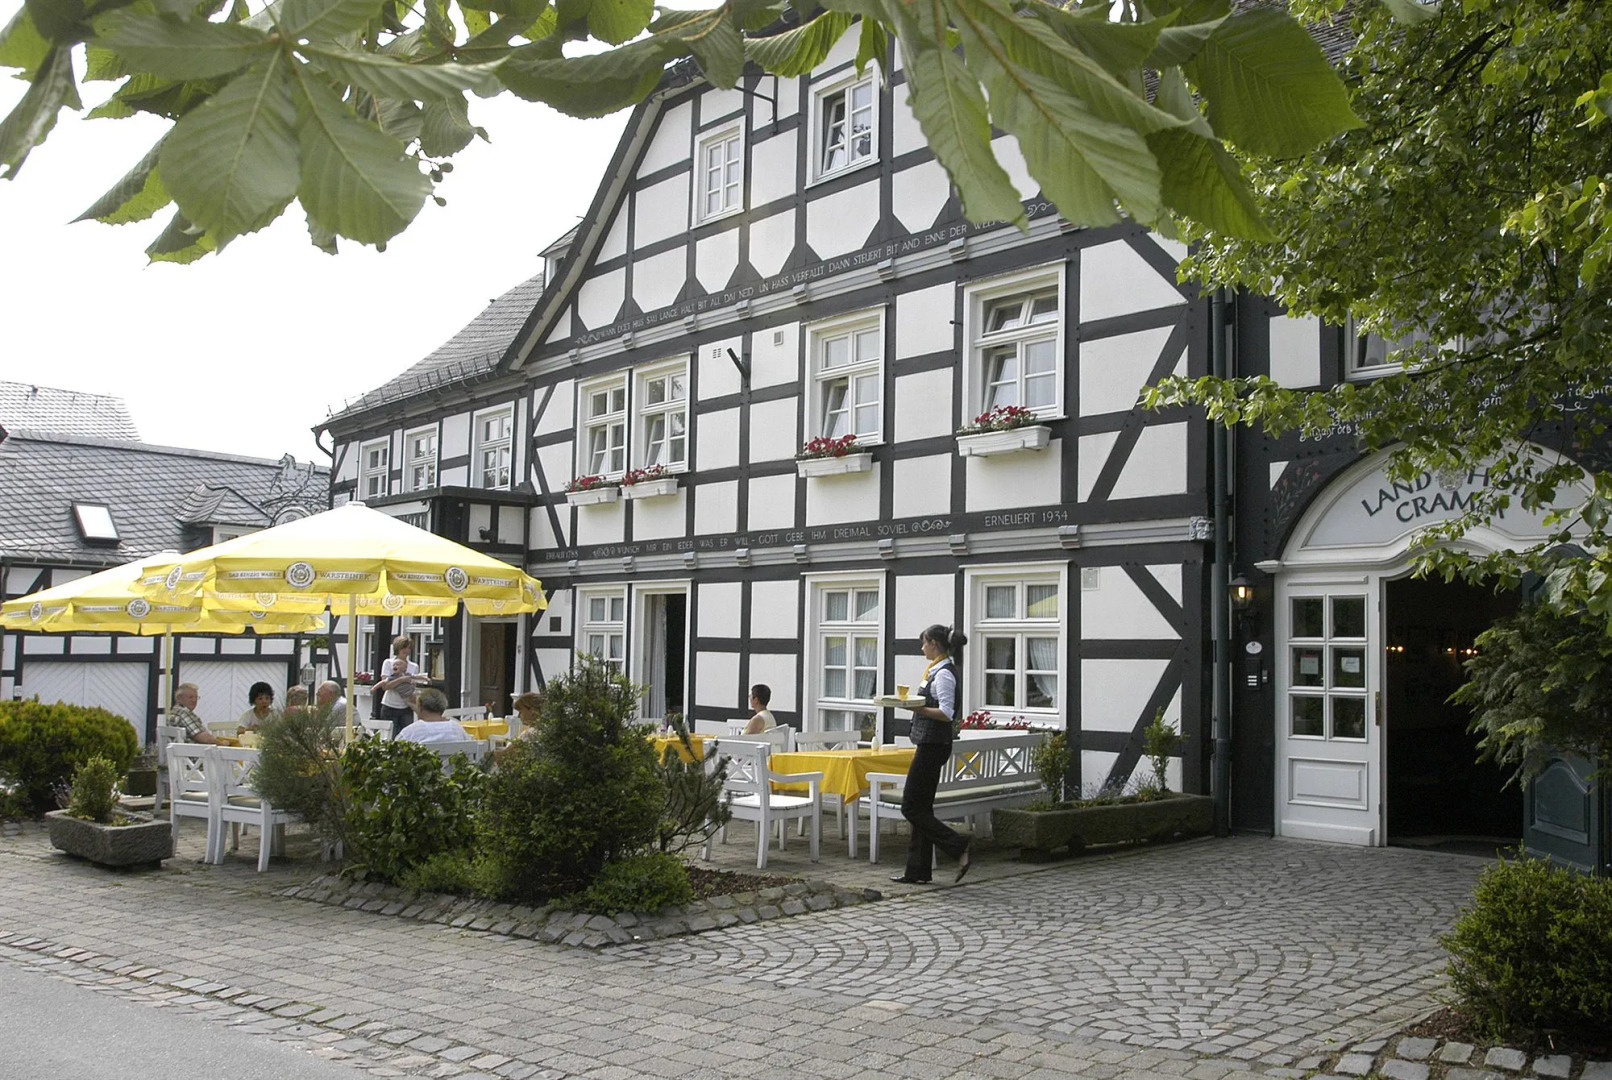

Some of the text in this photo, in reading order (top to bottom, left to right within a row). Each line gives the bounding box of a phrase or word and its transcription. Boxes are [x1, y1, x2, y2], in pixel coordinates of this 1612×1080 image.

[771, 275, 789, 290] HASS
[828, 258, 851, 273] DANN
[853, 248, 882, 266] STEUERT
[886, 243, 899, 256] BIT
[901, 238, 920, 253] AND
[924, 230, 946, 245] ENNE
[949, 224, 967, 237] DER
[1361, 472, 1432, 517] LAND
[984, 510, 1069, 527] ERNEUERT 1934
[758, 533, 778, 544] GOTT
[785, 531, 804, 542] GEBE
[811, 530, 827, 540] IHM
[833, 527, 871, 539] DREIMAL
[877, 524, 909, 535] SOVIEL
[320, 571, 371, 580] WARSTEINER
